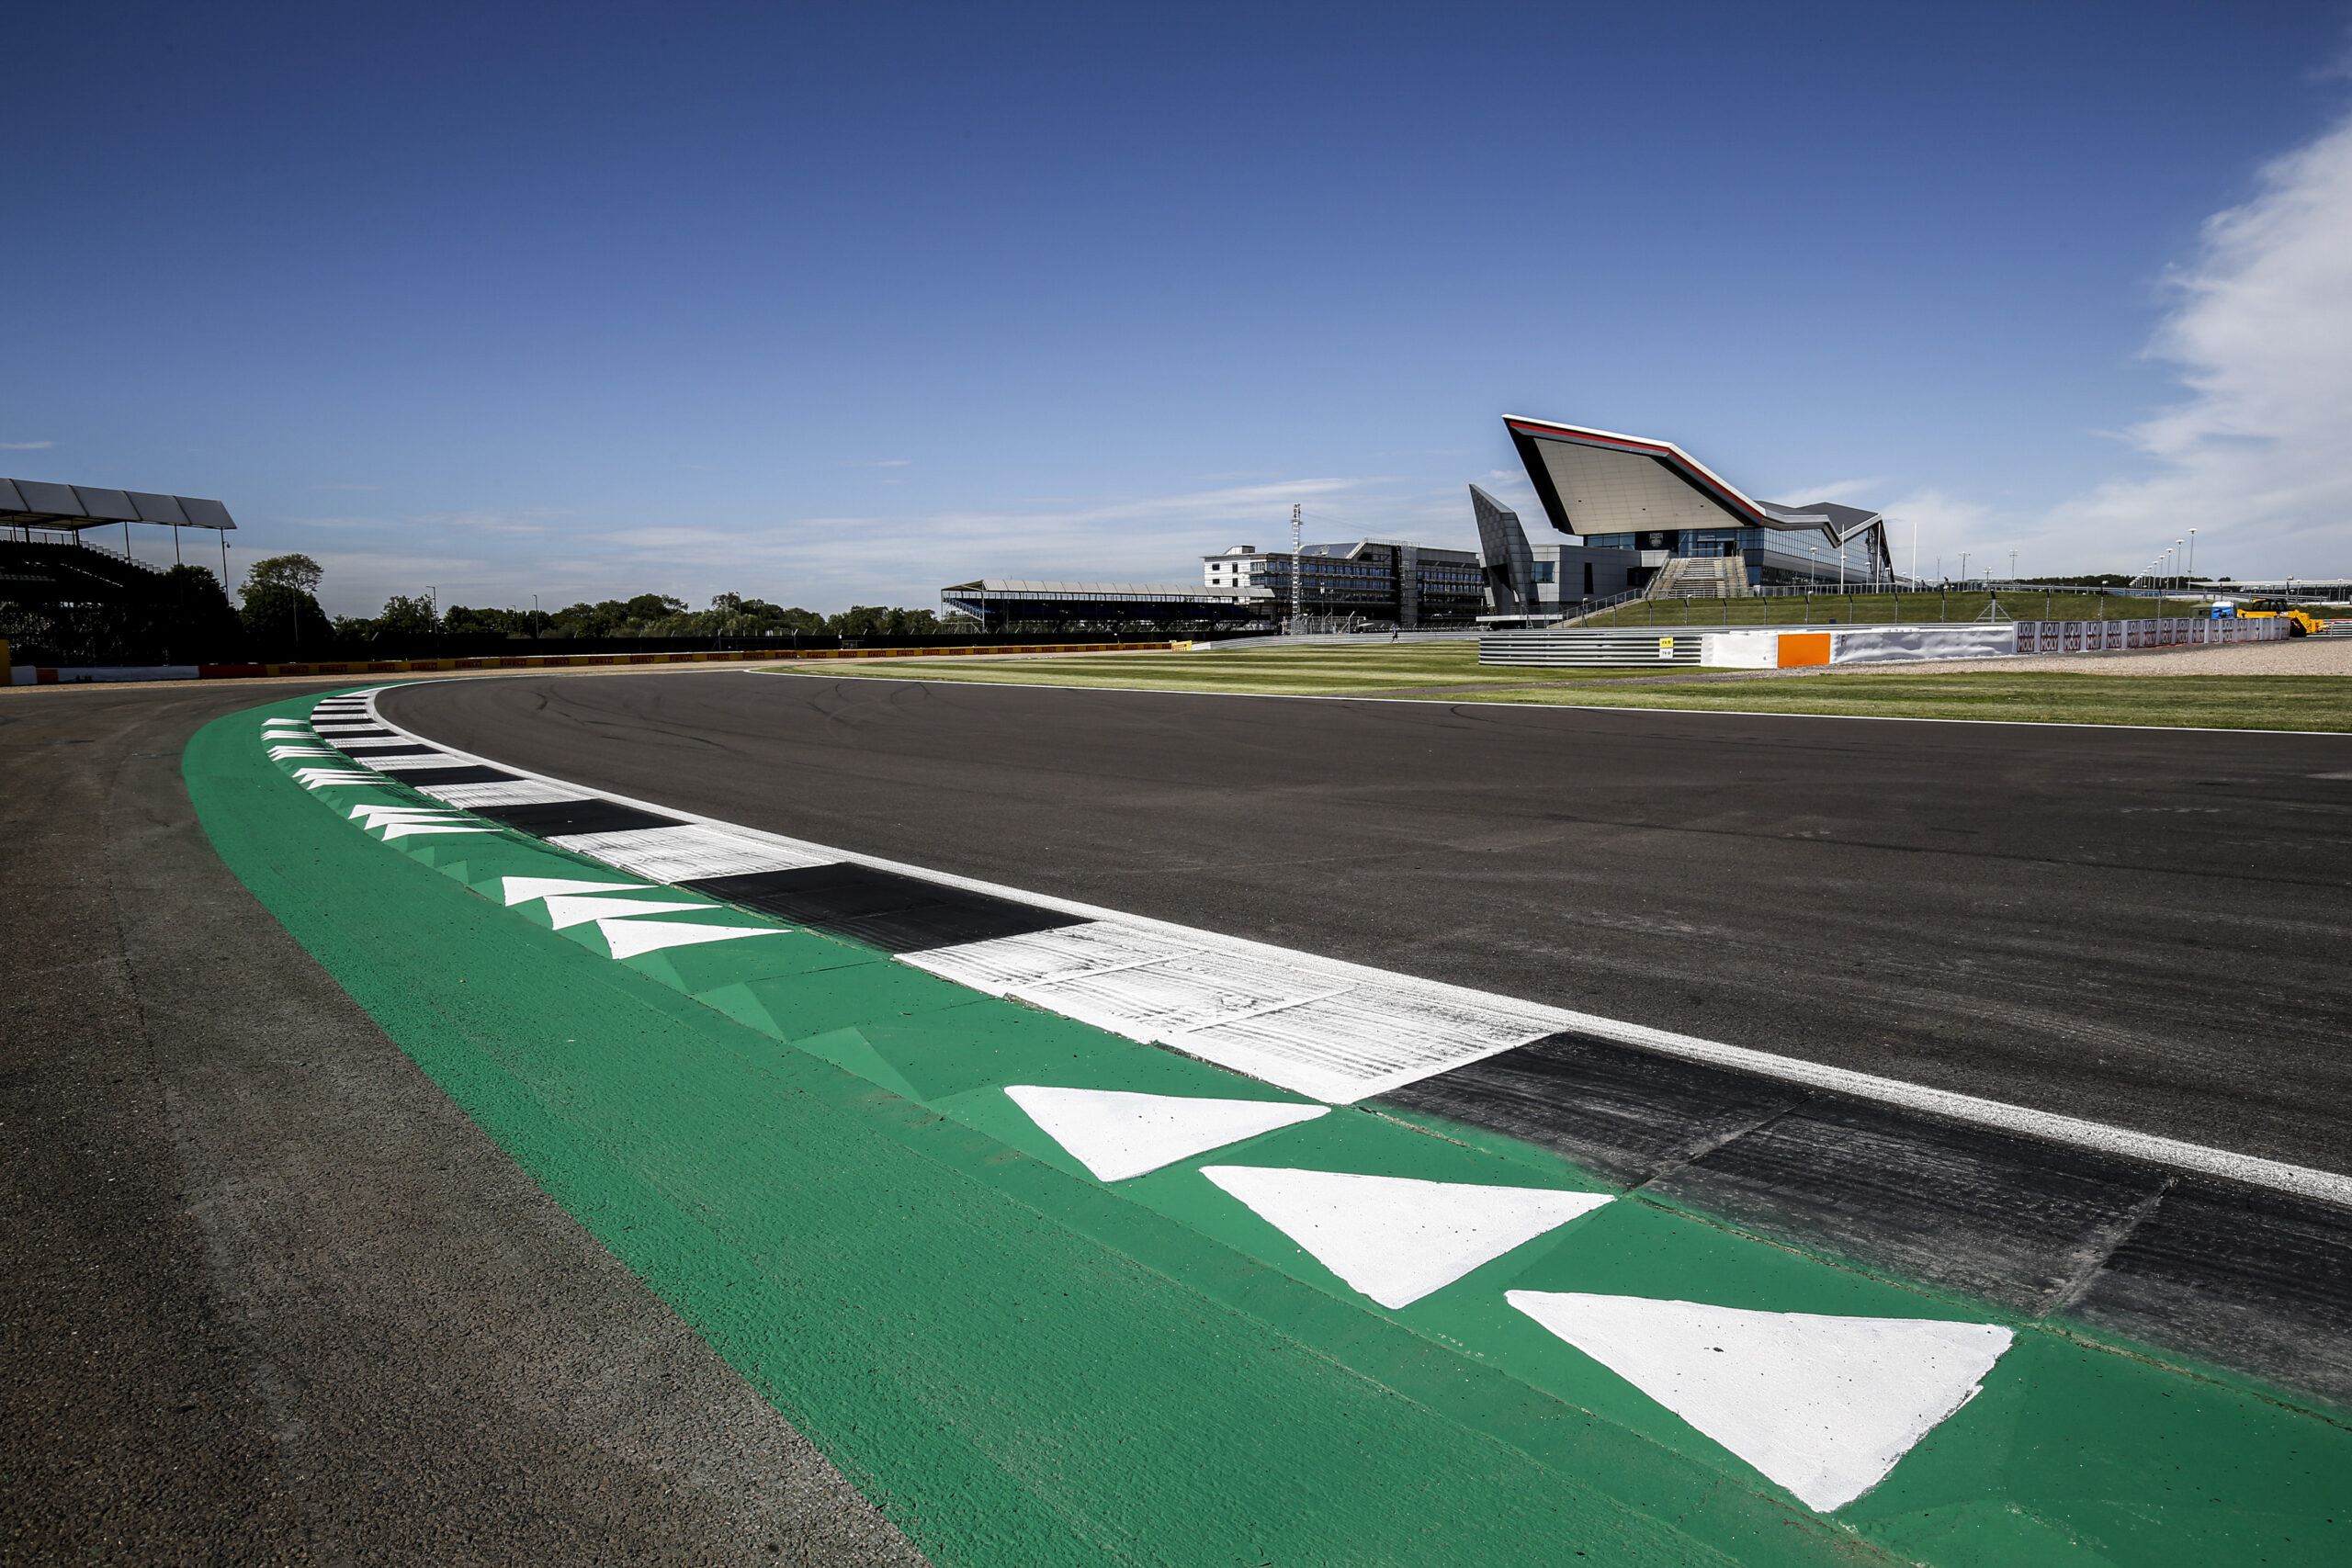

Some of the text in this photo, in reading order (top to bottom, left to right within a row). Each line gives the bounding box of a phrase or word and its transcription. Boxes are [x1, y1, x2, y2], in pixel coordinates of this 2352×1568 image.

[2018, 624, 2035, 636] LIQUI
[2041, 623, 2060, 636] LIQUI
[2064, 623, 2082, 636] LIQUI
[2086, 623, 2102, 635] LIQUI
[2108, 622, 2121, 634] LIQUI
[2017, 638, 2034, 651] MOLY
[2040, 637, 2058, 651] MOLY
[2064, 637, 2081, 650] MOLY
[2107, 636, 2121, 648] MOLY
